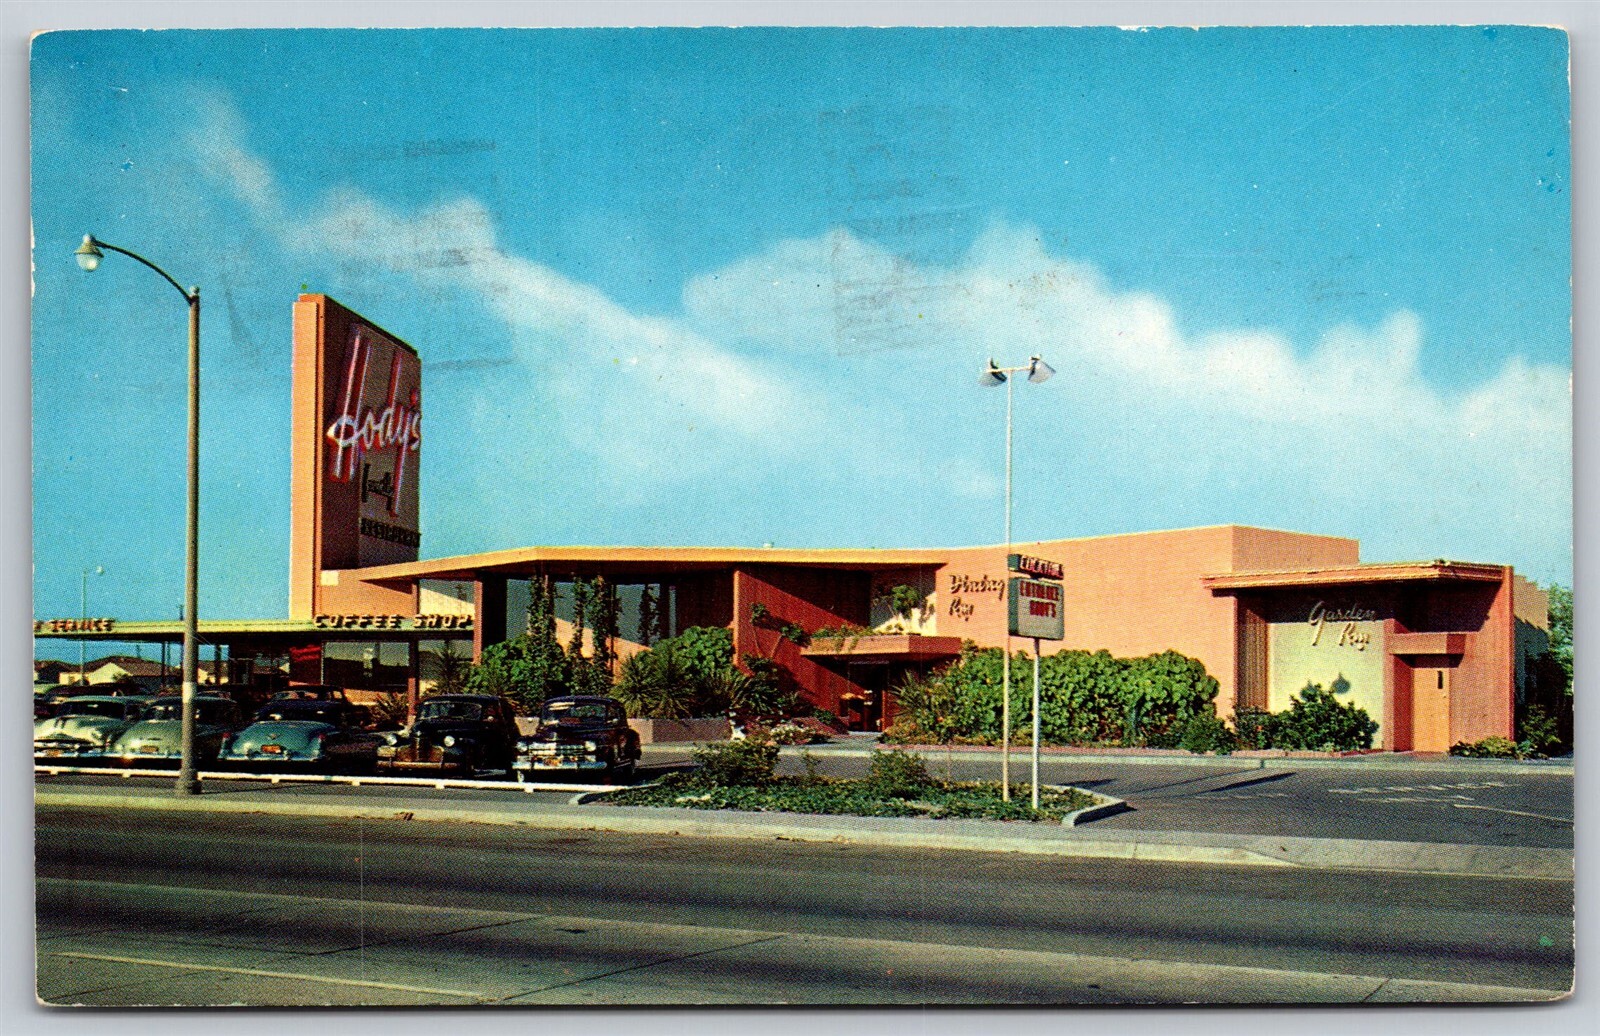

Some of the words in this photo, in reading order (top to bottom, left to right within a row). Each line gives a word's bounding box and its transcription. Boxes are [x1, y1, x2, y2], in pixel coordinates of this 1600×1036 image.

[327, 328, 421, 517] Hody's
[949, 574, 1006, 602] Dining
[312, 613, 404, 629] COFFEE
[412, 613, 474, 629] SHOP
[1308, 600, 1377, 647] Garden
